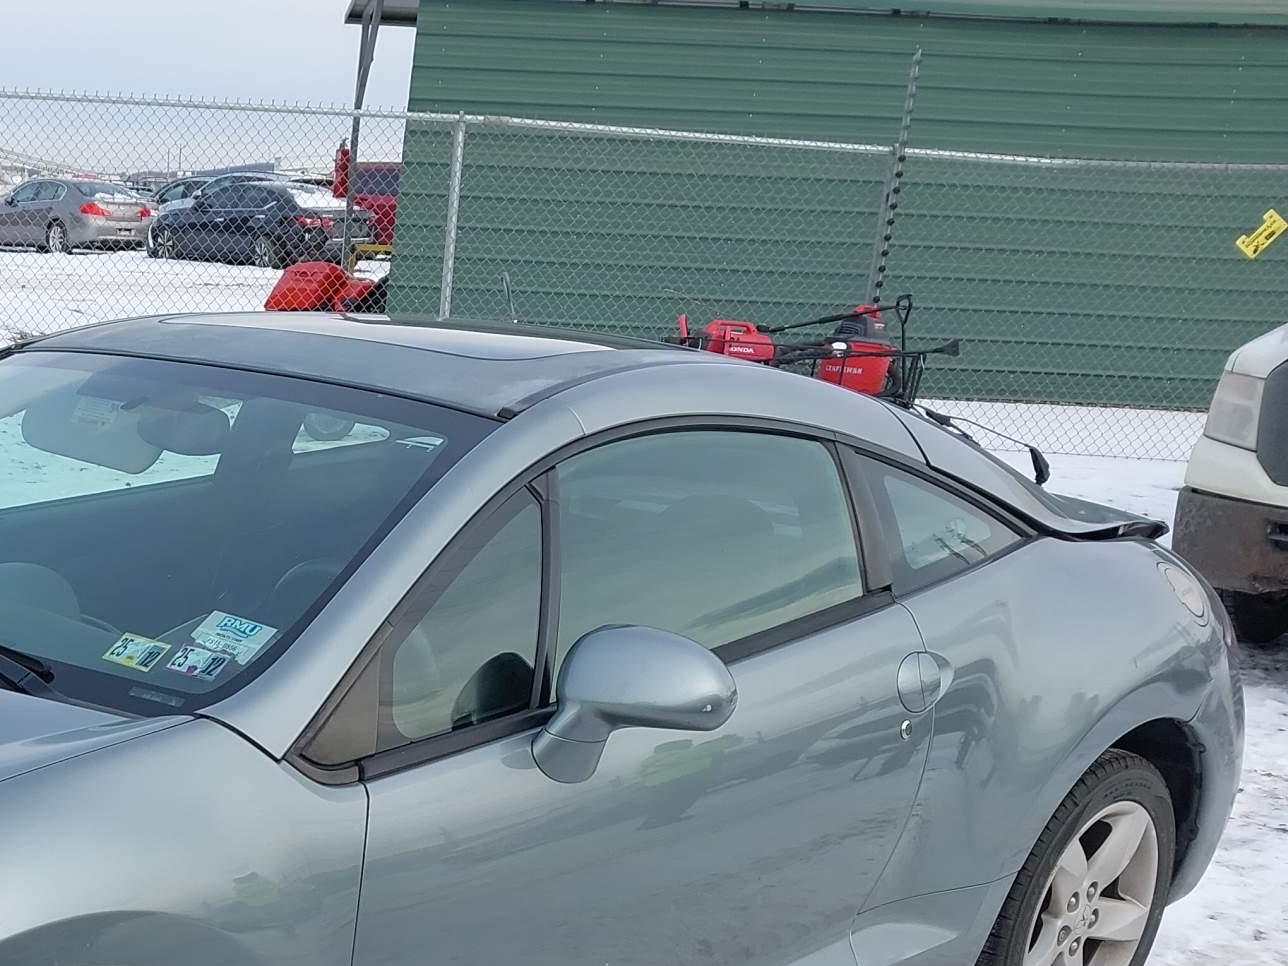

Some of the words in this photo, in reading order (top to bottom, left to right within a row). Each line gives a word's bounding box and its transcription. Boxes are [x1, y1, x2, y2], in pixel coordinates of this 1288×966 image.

[216, 616, 263, 637] RMU
[110, 637, 131, 657] 25
[171, 647, 194, 667] 25
[140, 650, 160, 668] 12
[202, 655, 226, 676] 12
